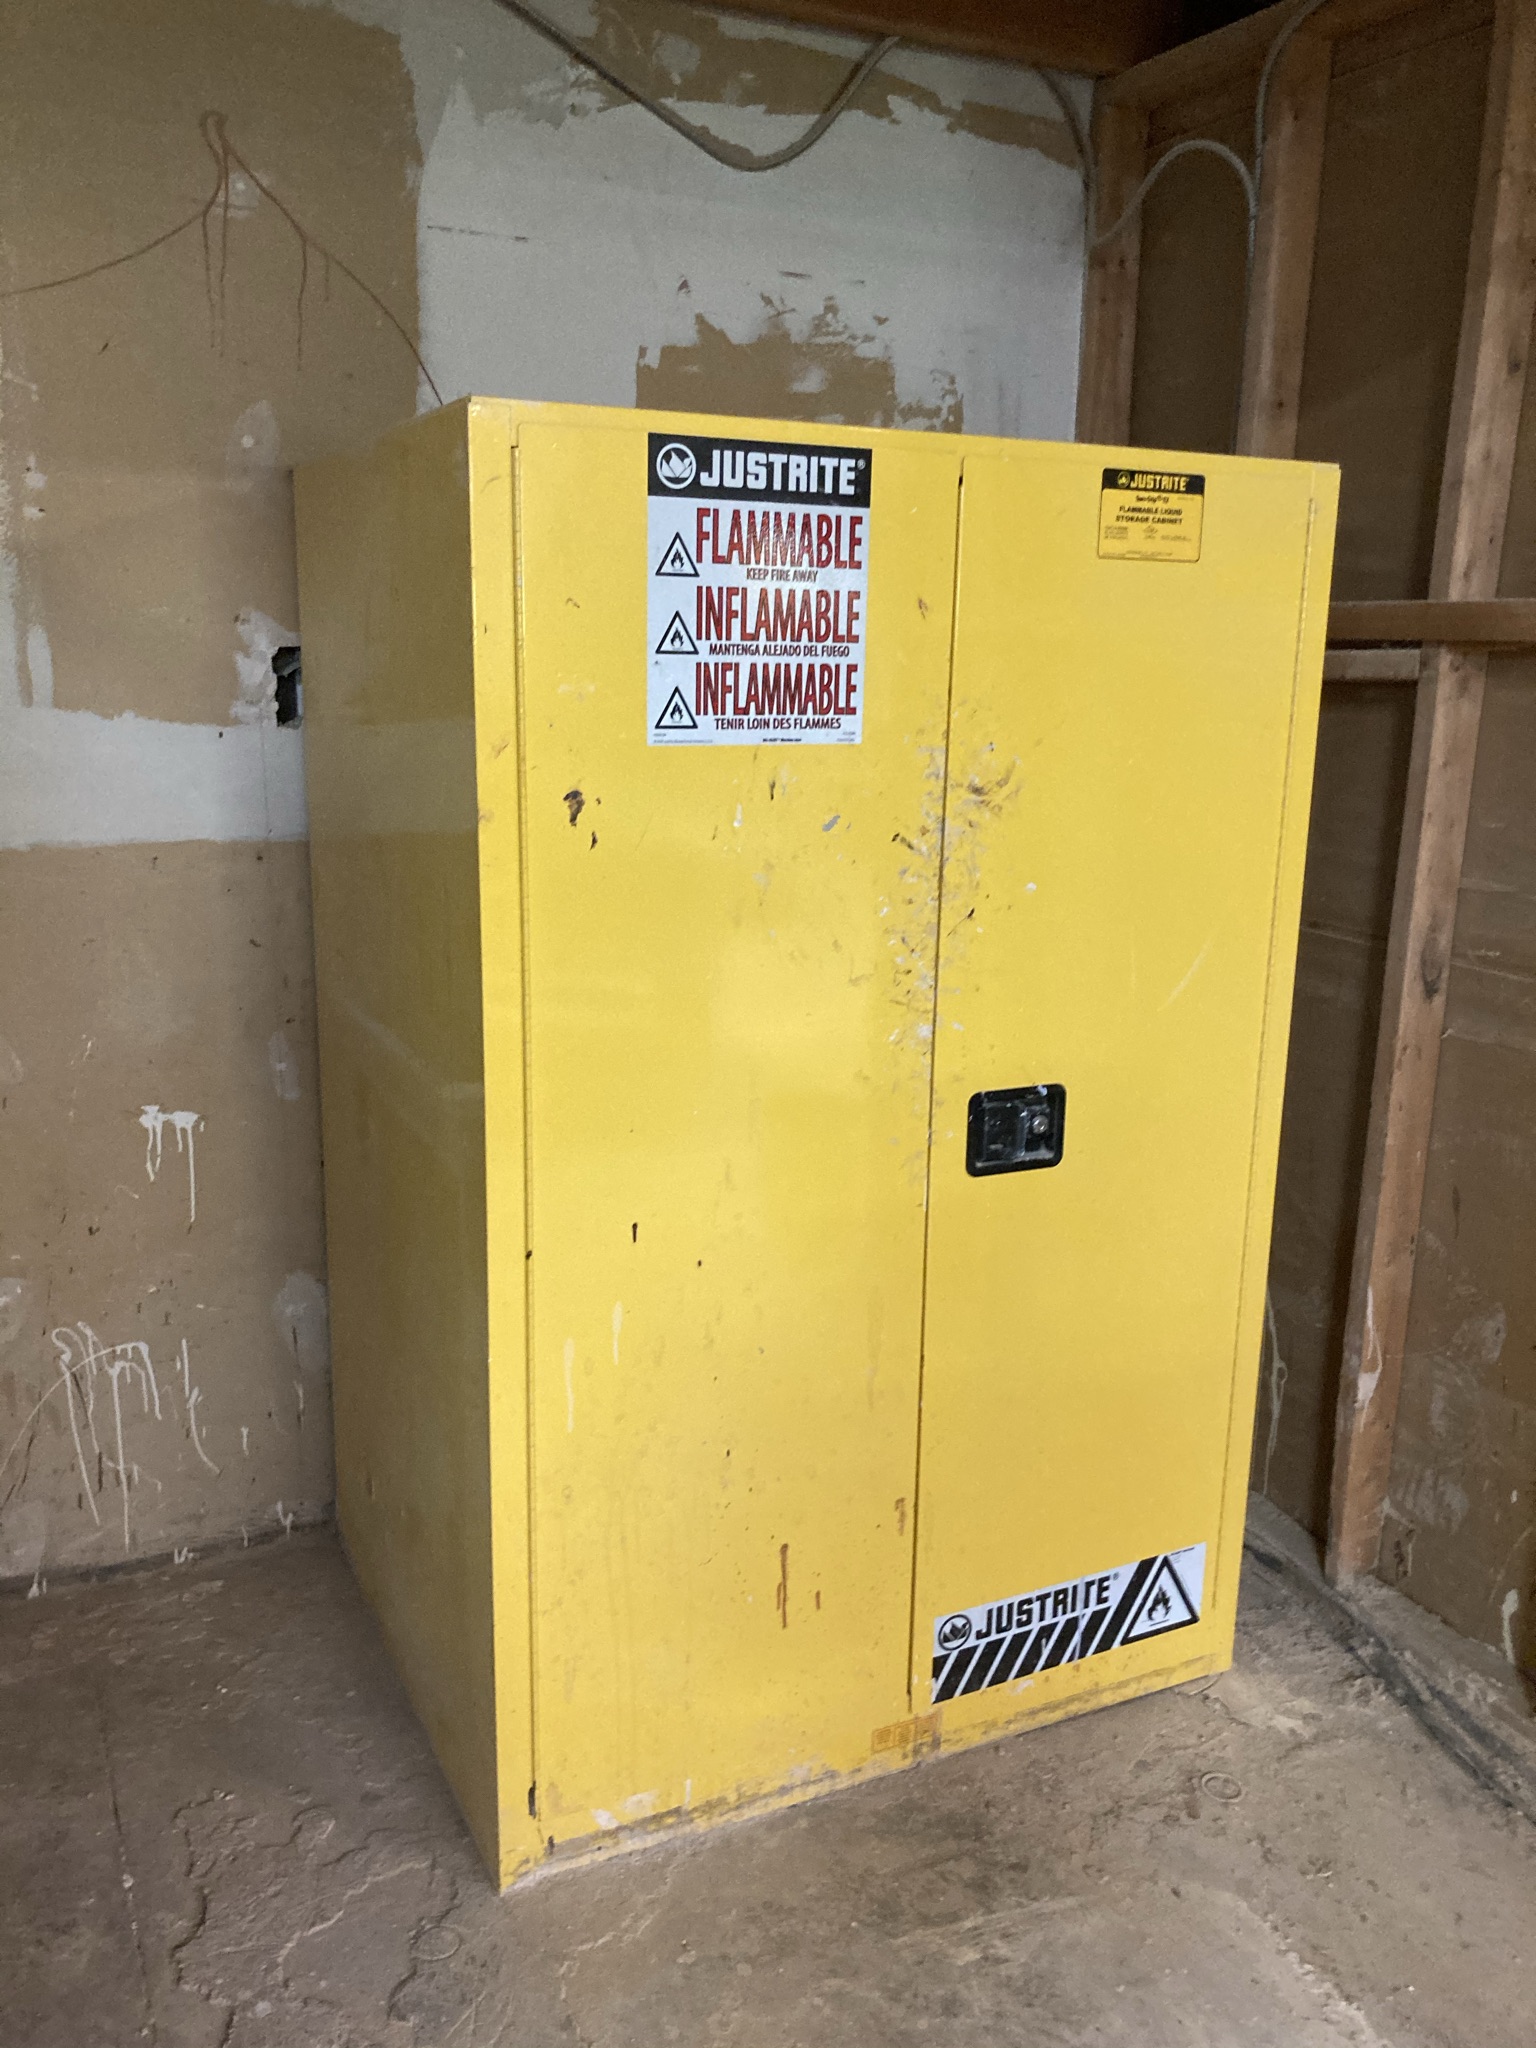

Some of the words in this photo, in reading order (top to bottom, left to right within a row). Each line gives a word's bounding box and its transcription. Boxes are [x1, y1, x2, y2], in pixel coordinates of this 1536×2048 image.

[695, 507, 863, 568] FLAMMABLE
[746, 567, 769, 581] KEEP
[771, 568, 791, 582] FIRE
[792, 569, 818, 583] AWAY
[695, 585, 861, 643] INFLAMABLE
[709, 643, 761, 657] MANTENGA
[762, 644, 802, 657] ALEJADO
[803, 645, 820, 657] DEL
[821, 645, 850, 658] FUEGO
[695, 662, 859, 716] INFLAMMABLE
[714, 717, 745, 730] TENIR
[747, 718, 771, 730] LOIN
[773, 718, 792, 730] DES
[793, 717, 842, 730] FLAMMES
